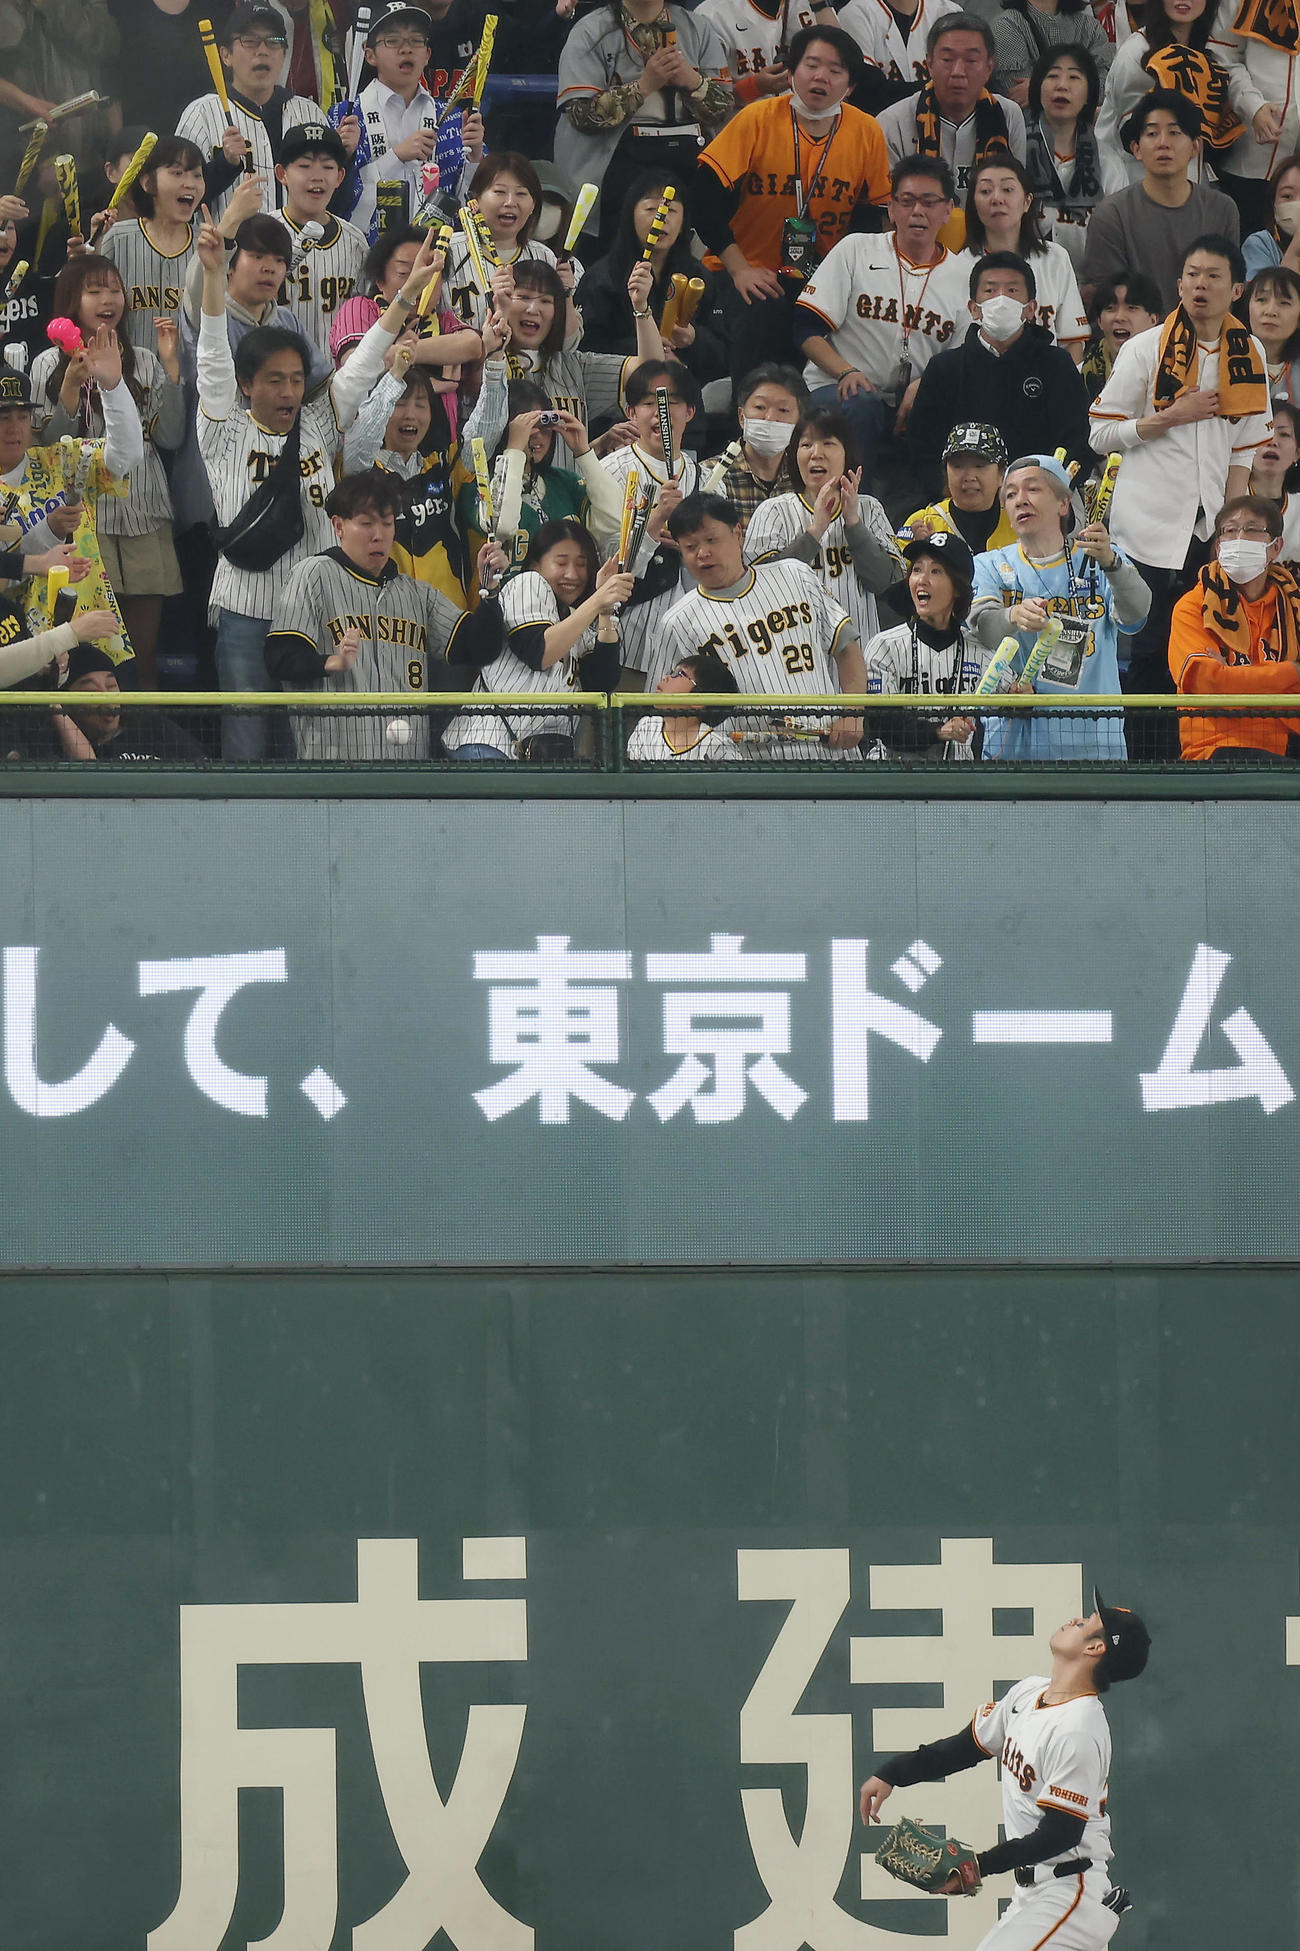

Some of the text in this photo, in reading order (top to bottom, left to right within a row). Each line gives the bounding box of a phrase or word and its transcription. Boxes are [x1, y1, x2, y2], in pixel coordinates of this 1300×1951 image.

[856, 294, 955, 343] GIANTS
[697, 602, 813, 668] Tigers
[407, 660, 423, 689] 8
[782, 642, 815, 675] 29
